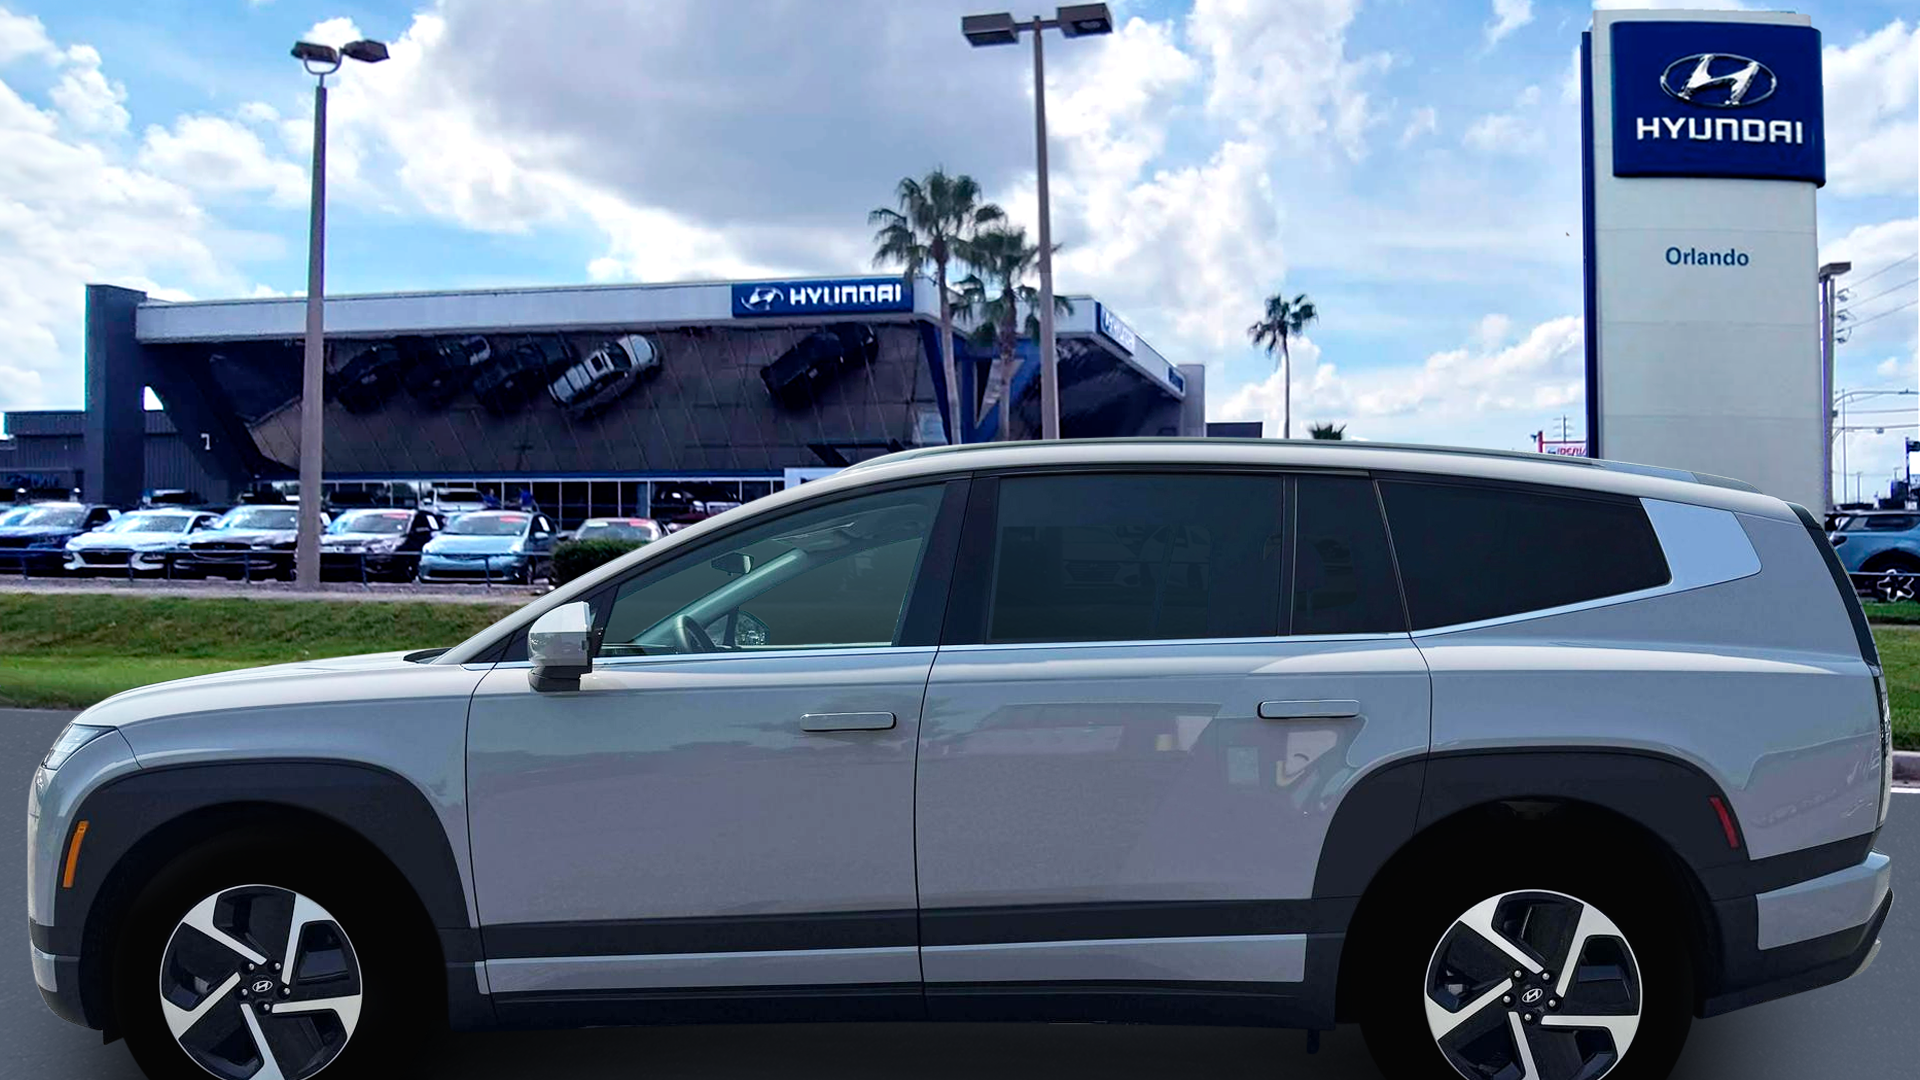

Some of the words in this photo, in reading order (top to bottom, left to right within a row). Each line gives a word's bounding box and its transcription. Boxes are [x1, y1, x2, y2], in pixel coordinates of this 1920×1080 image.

[1636, 117, 1803, 144] HYUNDAI
[1665, 246, 1750, 267] Orlando
[789, 283, 901, 306] HYUNDAI
